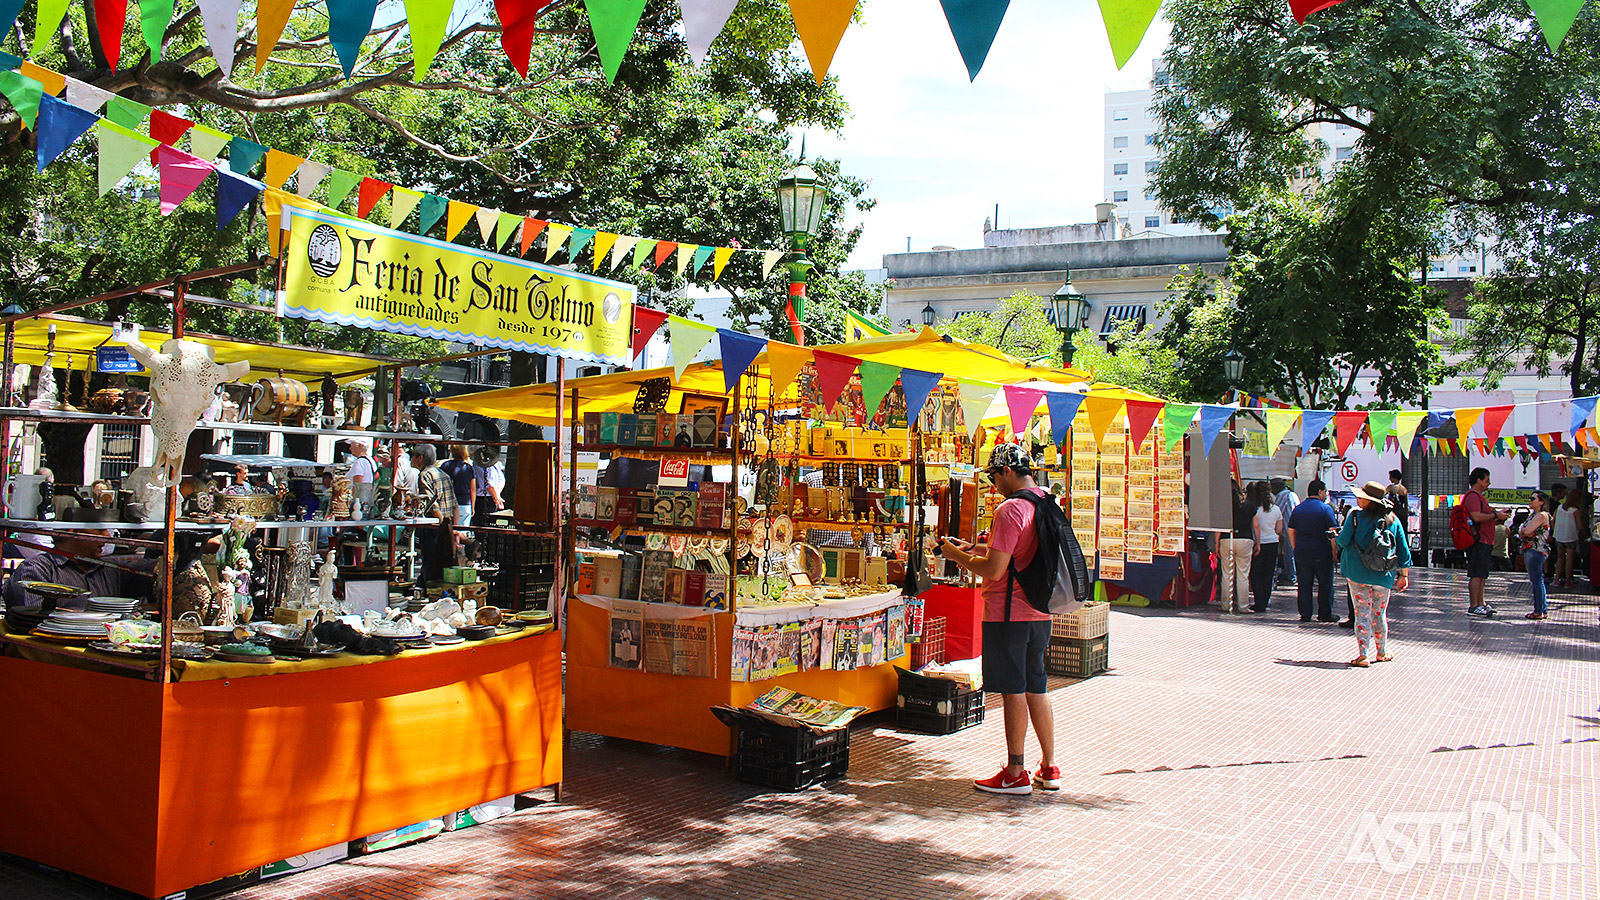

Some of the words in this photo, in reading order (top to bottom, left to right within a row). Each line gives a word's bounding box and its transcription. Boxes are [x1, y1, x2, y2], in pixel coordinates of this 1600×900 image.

[339, 229, 424, 297] Feria
[434, 256, 461, 304] de
[463, 260, 520, 315] San
[525, 273, 595, 328] Telmo
[498, 317, 536, 335] desde
[1487, 489, 1506, 499] Feria
[1507, 490, 1514, 499] de
[1515, 491, 1530, 500] San
